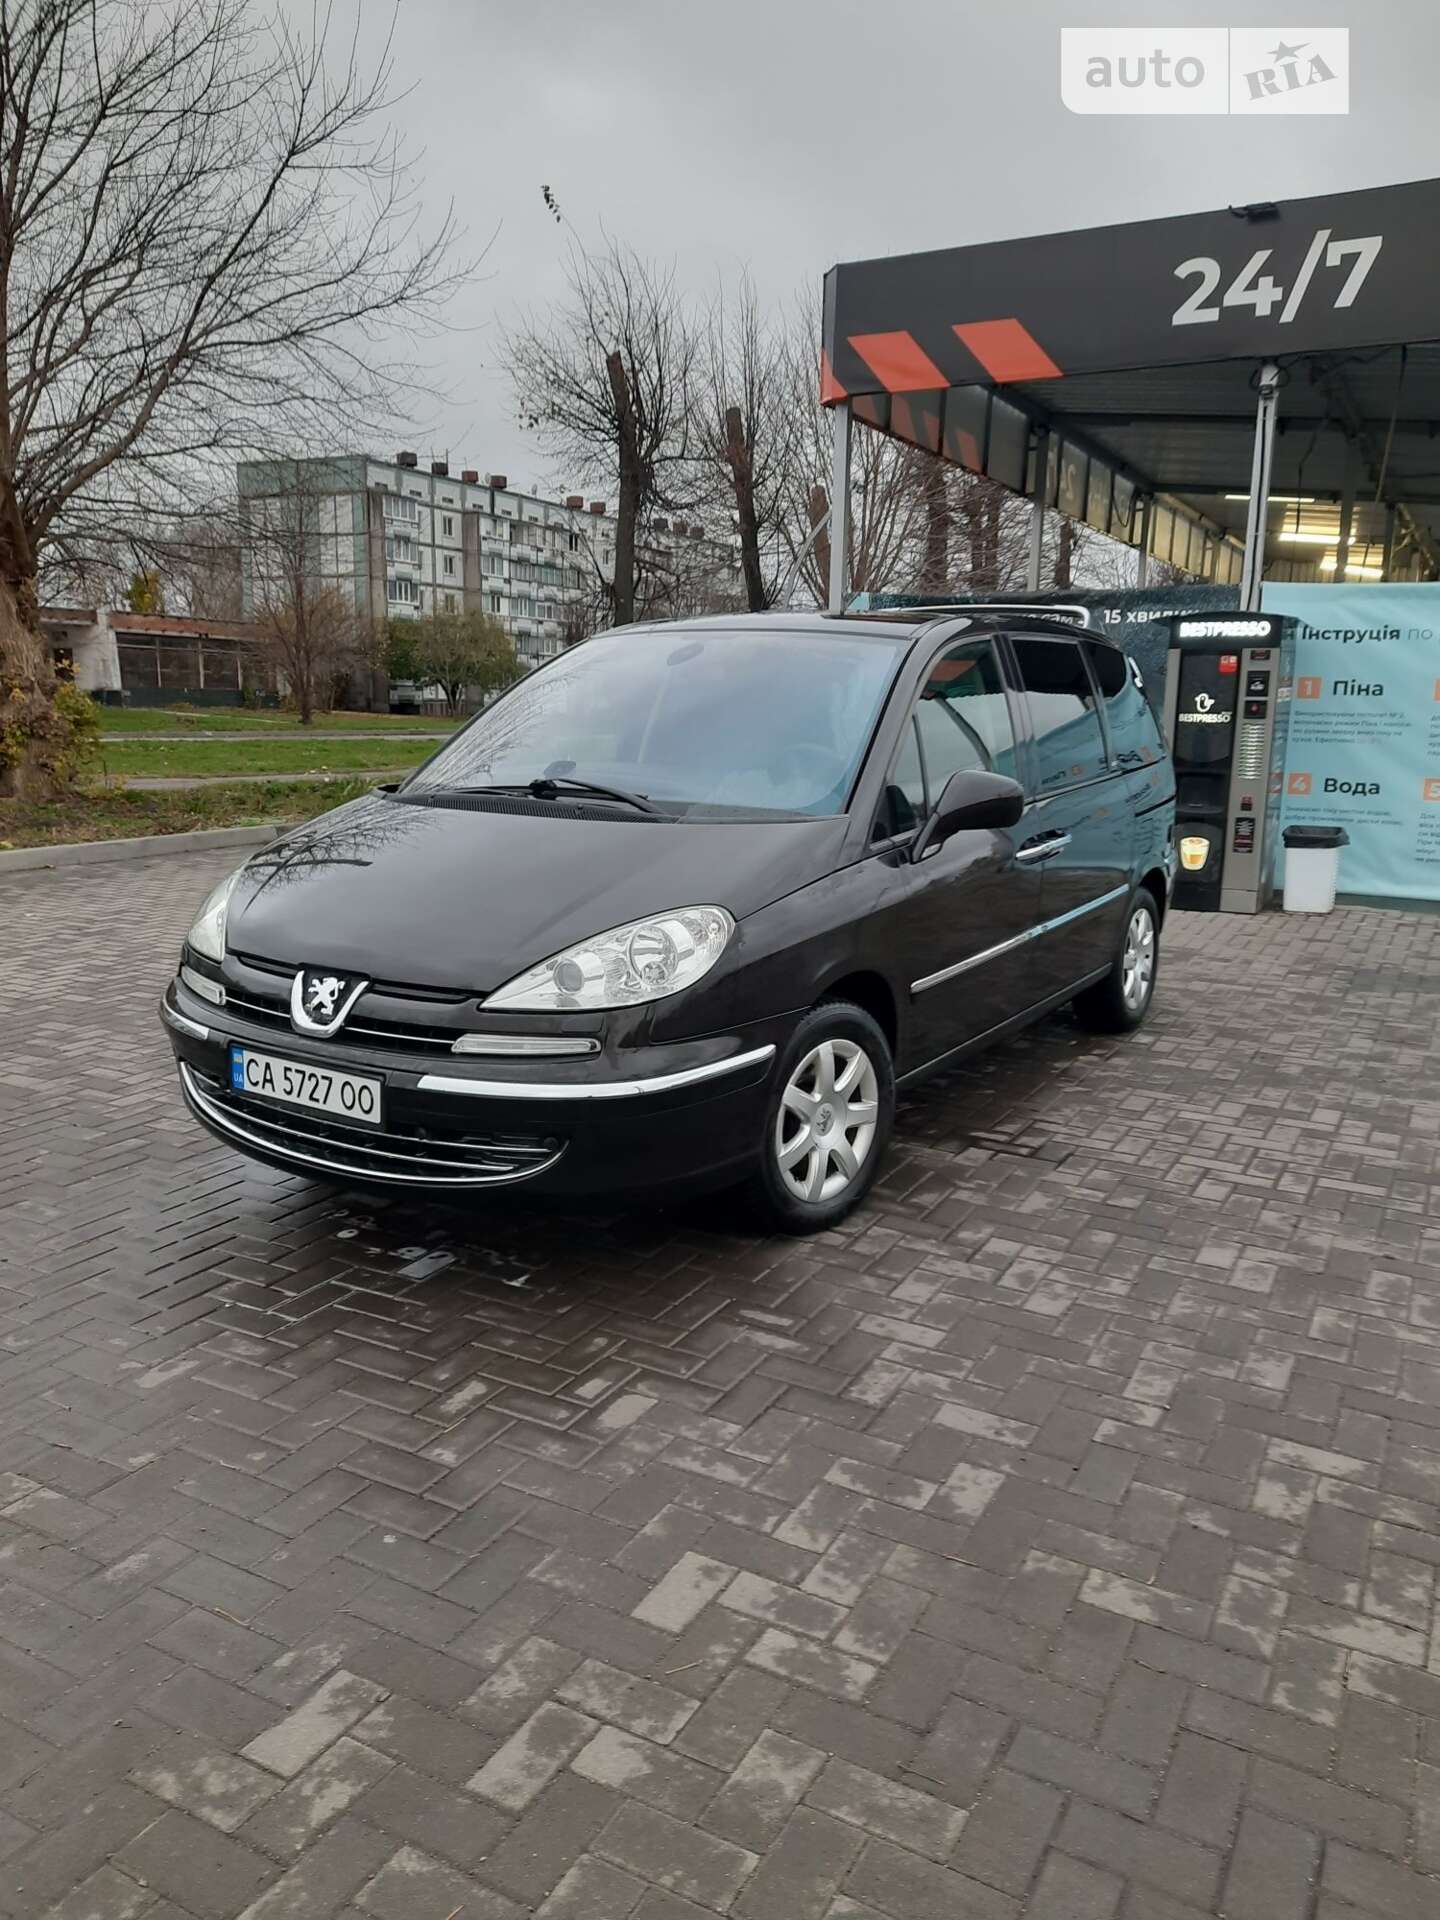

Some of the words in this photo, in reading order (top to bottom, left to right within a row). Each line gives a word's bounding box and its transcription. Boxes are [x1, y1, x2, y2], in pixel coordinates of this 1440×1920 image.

[1172, 228, 1384, 327] 24/7
[1103, 609, 1122, 624] 15
[1179, 620, 1272, 638] BESTPRESSO
[1408, 628, 1433, 640] по
[1332, 678, 1385, 697] Піна
[1323, 777, 1381, 797] Вода
[233, 1072, 243, 1083] UA
[246, 1058, 276, 1093] CA
[283, 1065, 333, 1105] 5727
[340, 1080, 374, 1115] OO
